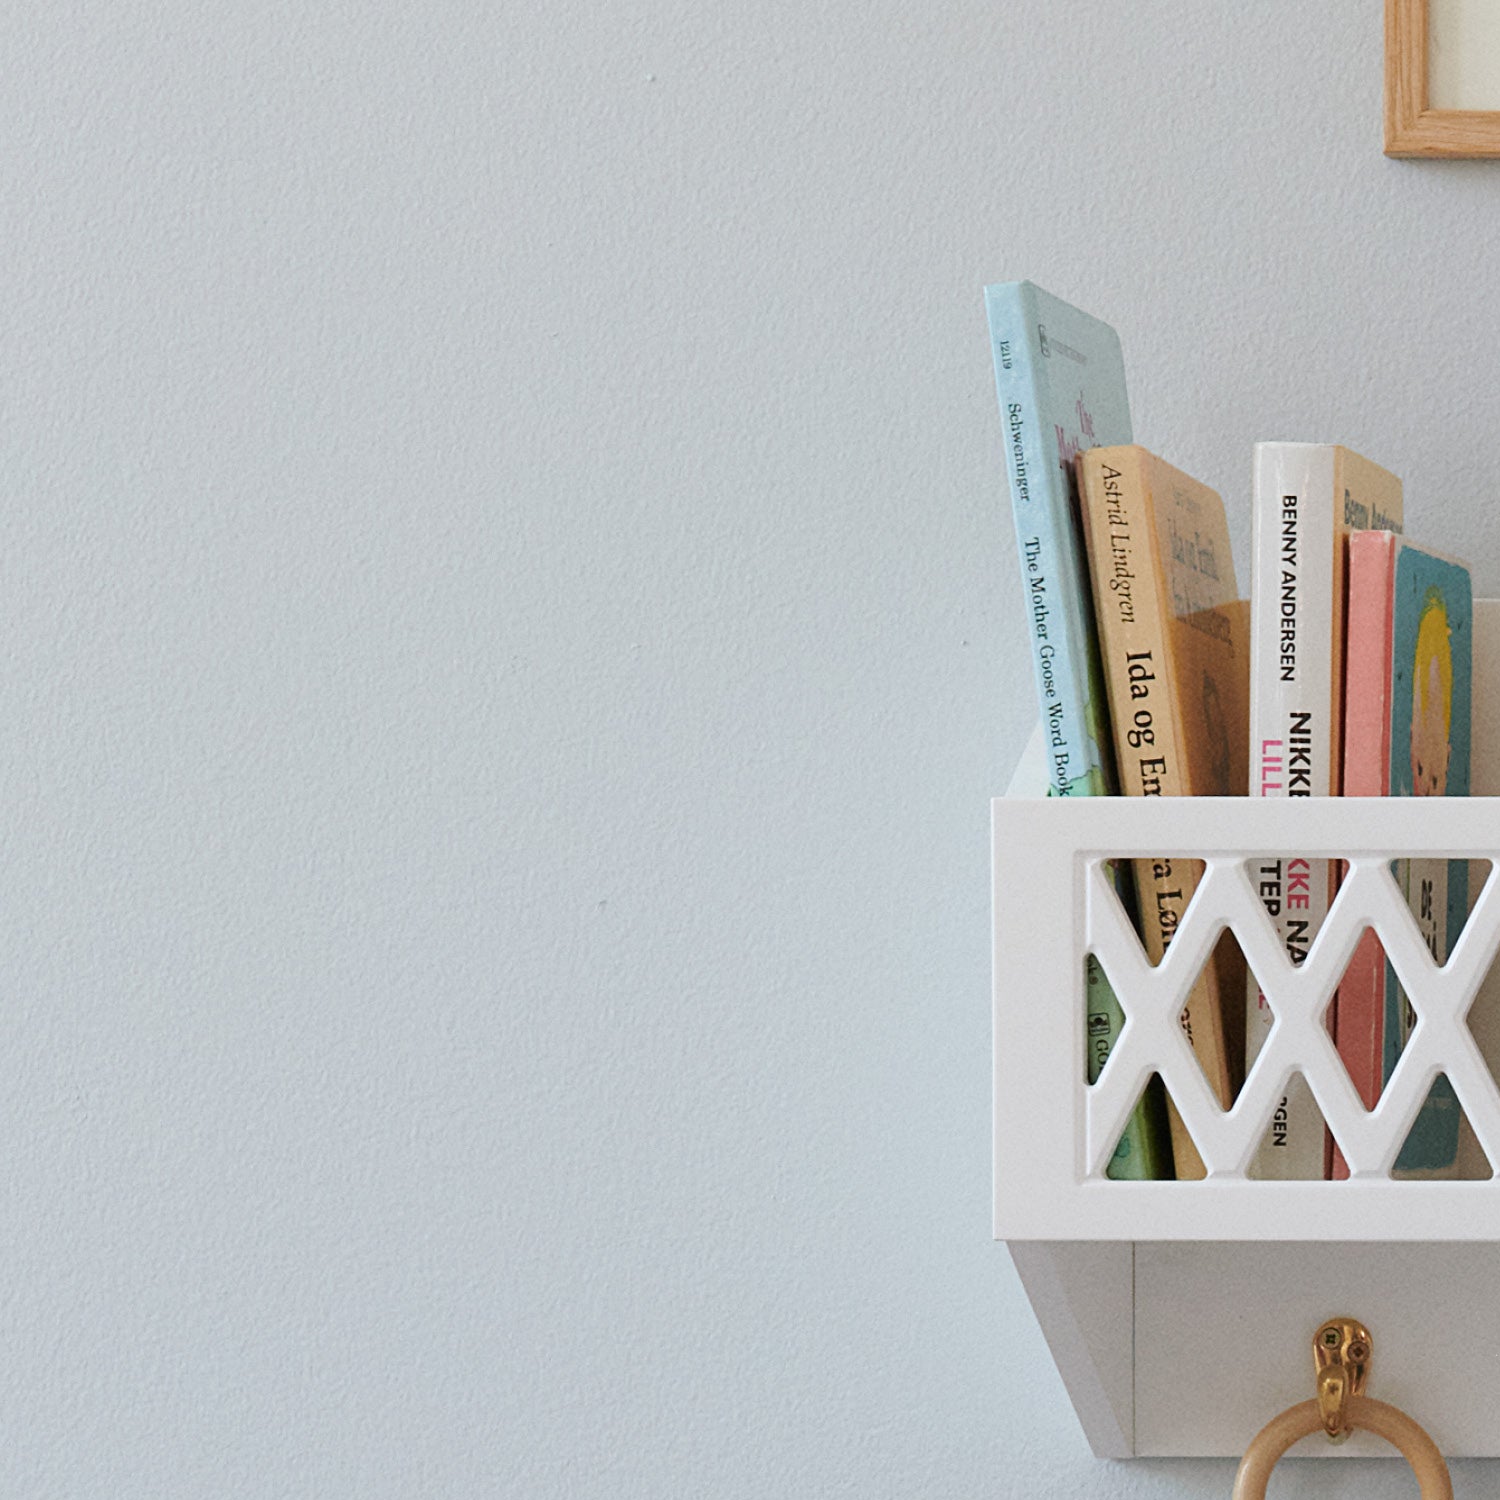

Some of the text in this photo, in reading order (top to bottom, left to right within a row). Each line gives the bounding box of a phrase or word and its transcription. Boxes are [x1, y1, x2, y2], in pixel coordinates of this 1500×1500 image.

[1008, 403, 1031, 502] Schweninger
[1024, 536, 1040, 572] The
[1101, 463, 1136, 624] Astrid Lindgren
[1030, 576, 1050, 640] Mother
[1280, 495, 1297, 681] BENNY ANDERSEN
[1039, 644, 1056, 698] Goose
[1126, 651, 1156, 700] Ida
[1048, 702, 1067, 748] Word
[1127, 710, 1155, 749] og
[1262, 740, 1283, 797] LILL
